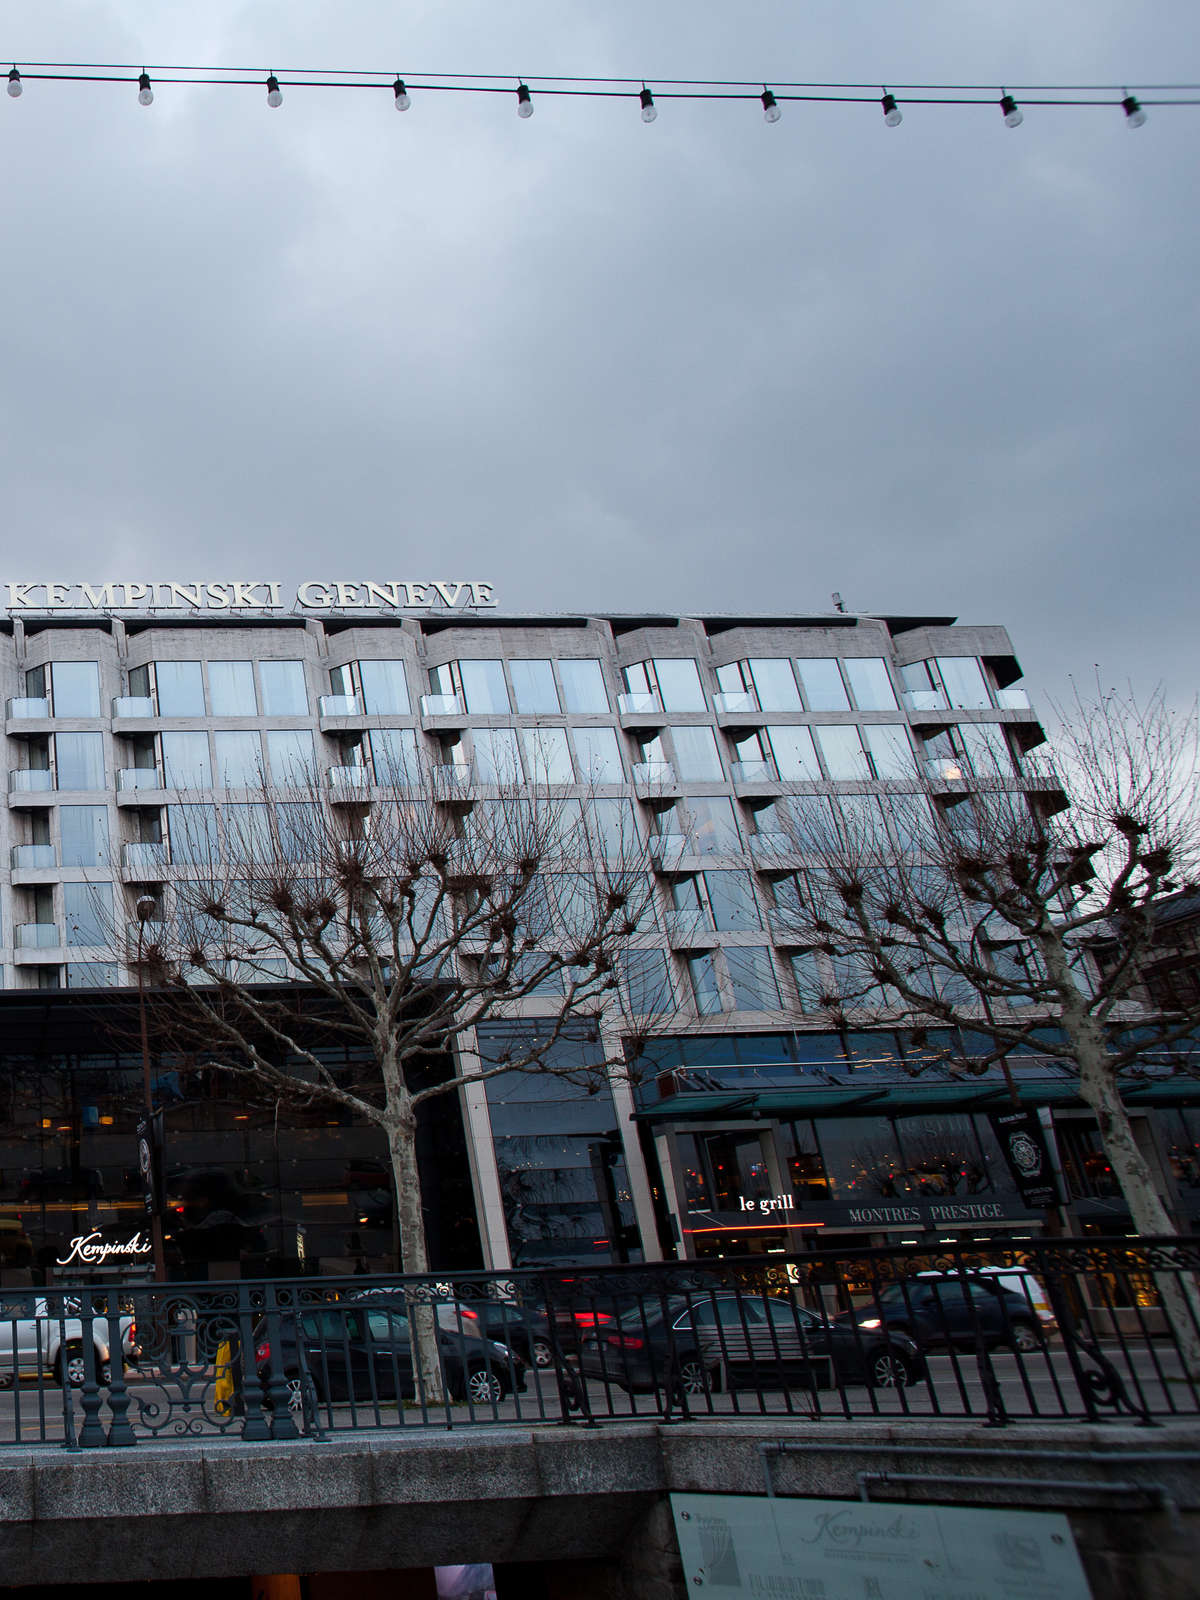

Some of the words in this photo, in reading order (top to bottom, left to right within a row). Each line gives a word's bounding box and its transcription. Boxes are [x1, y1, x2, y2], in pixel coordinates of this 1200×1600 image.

[3, 582, 285, 610] KEMPINSKI
[296, 581, 499, 609] GENEVE
[738, 1195, 756, 1211] le
[759, 1194, 795, 1216] grill
[848, 1207, 921, 1223] MONTRES
[929, 1203, 1004, 1220] PRESTIGE
[56, 1232, 152, 1265] Kempinski
[800, 1510, 921, 1545] Kempinski
